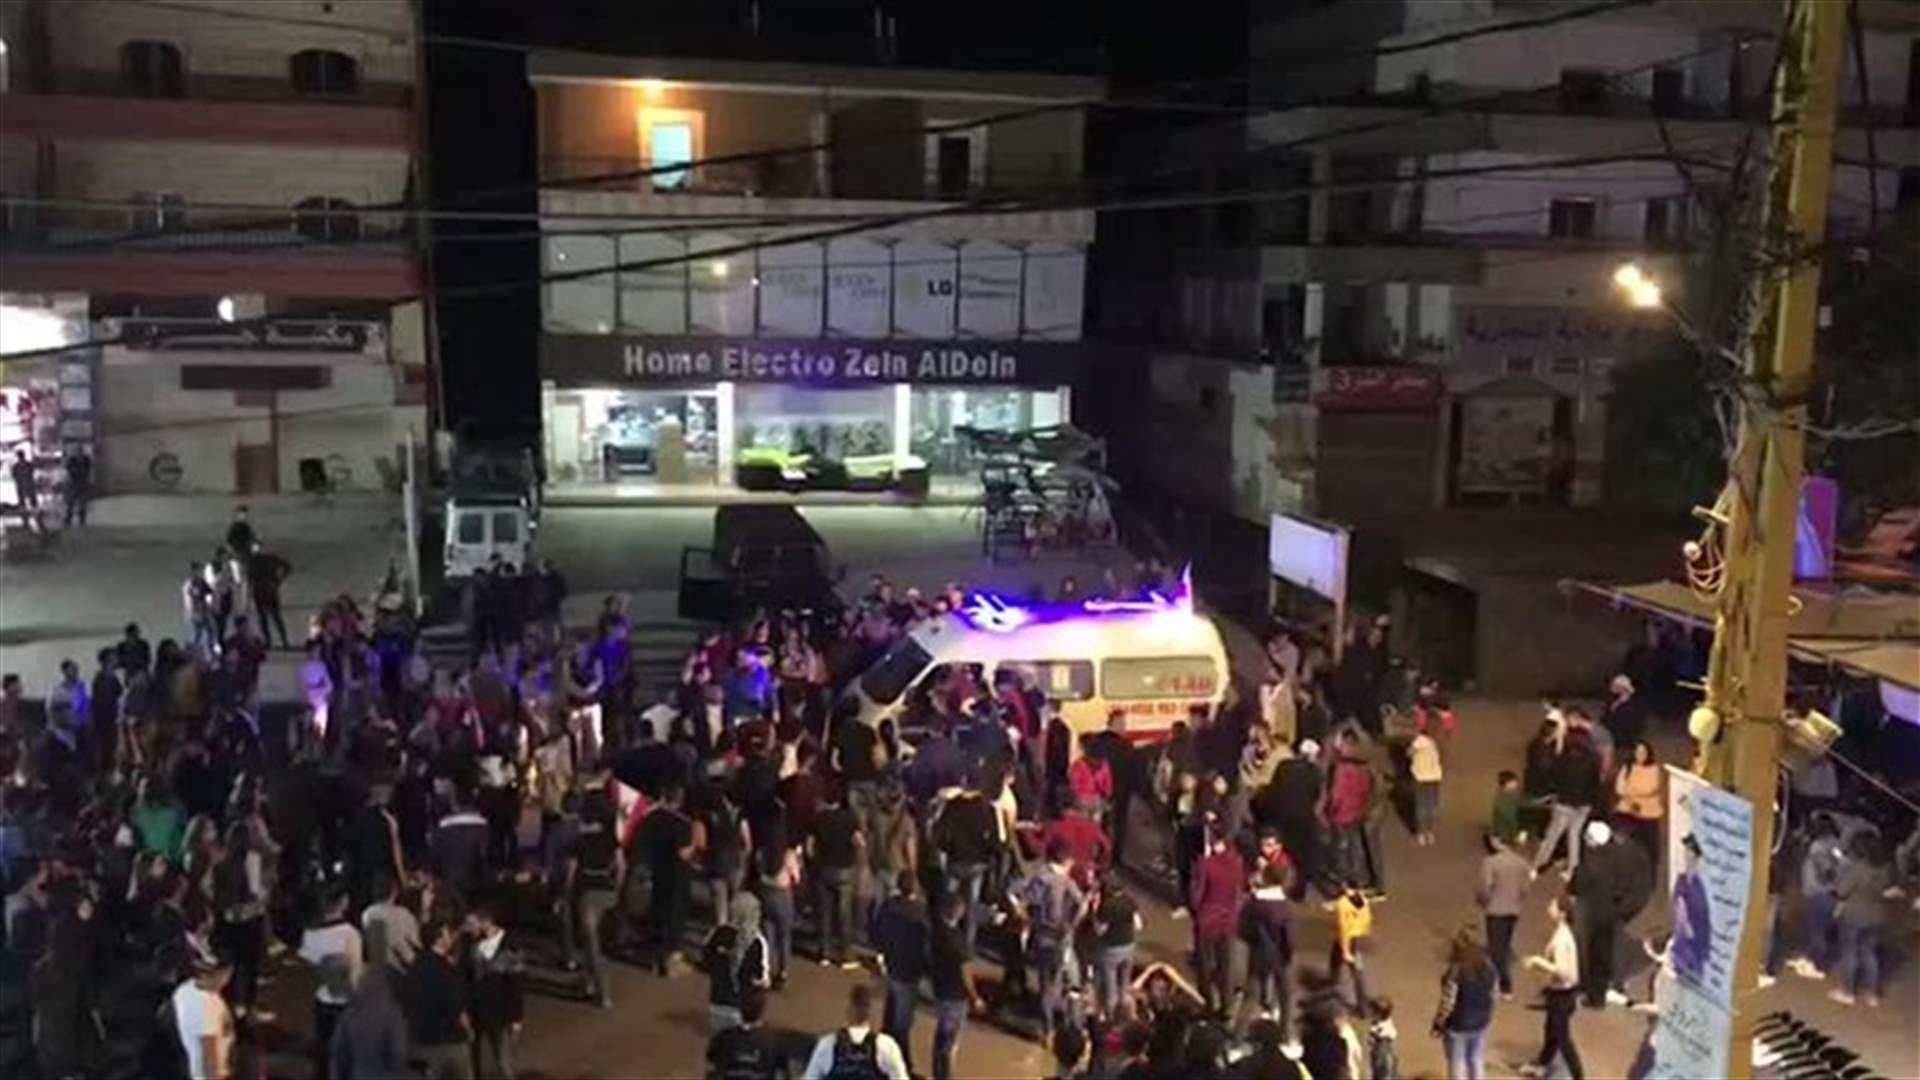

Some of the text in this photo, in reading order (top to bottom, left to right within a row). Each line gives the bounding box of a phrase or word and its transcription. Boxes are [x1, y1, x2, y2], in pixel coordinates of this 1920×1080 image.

[928, 278, 953, 297] LG
[623, 344, 711, 377] Home
[722, 346, 836, 377] Electro
